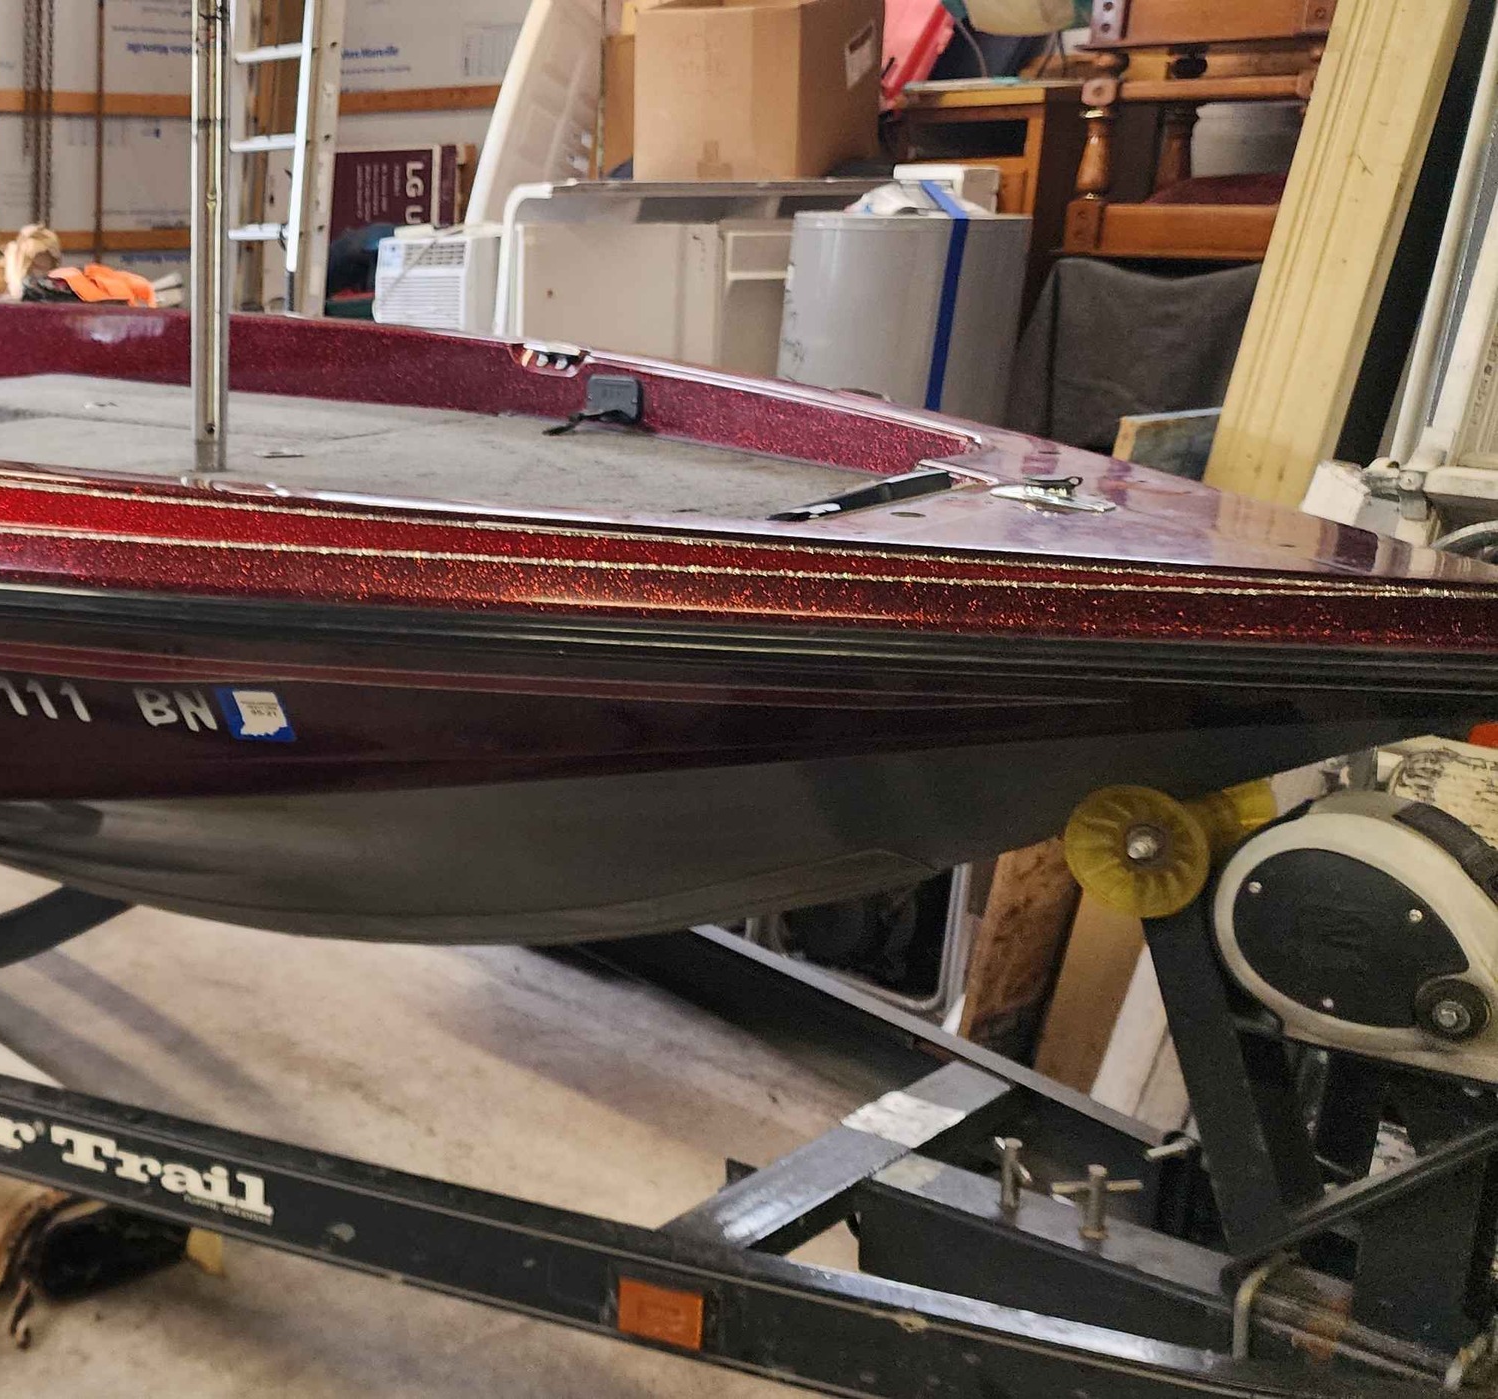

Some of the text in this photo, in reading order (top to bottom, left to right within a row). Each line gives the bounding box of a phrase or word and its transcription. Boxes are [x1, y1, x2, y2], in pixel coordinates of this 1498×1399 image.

[405, 161, 425, 198] LG
[133, 687, 218, 733] BN
[50, 1124, 275, 1219] Trail
